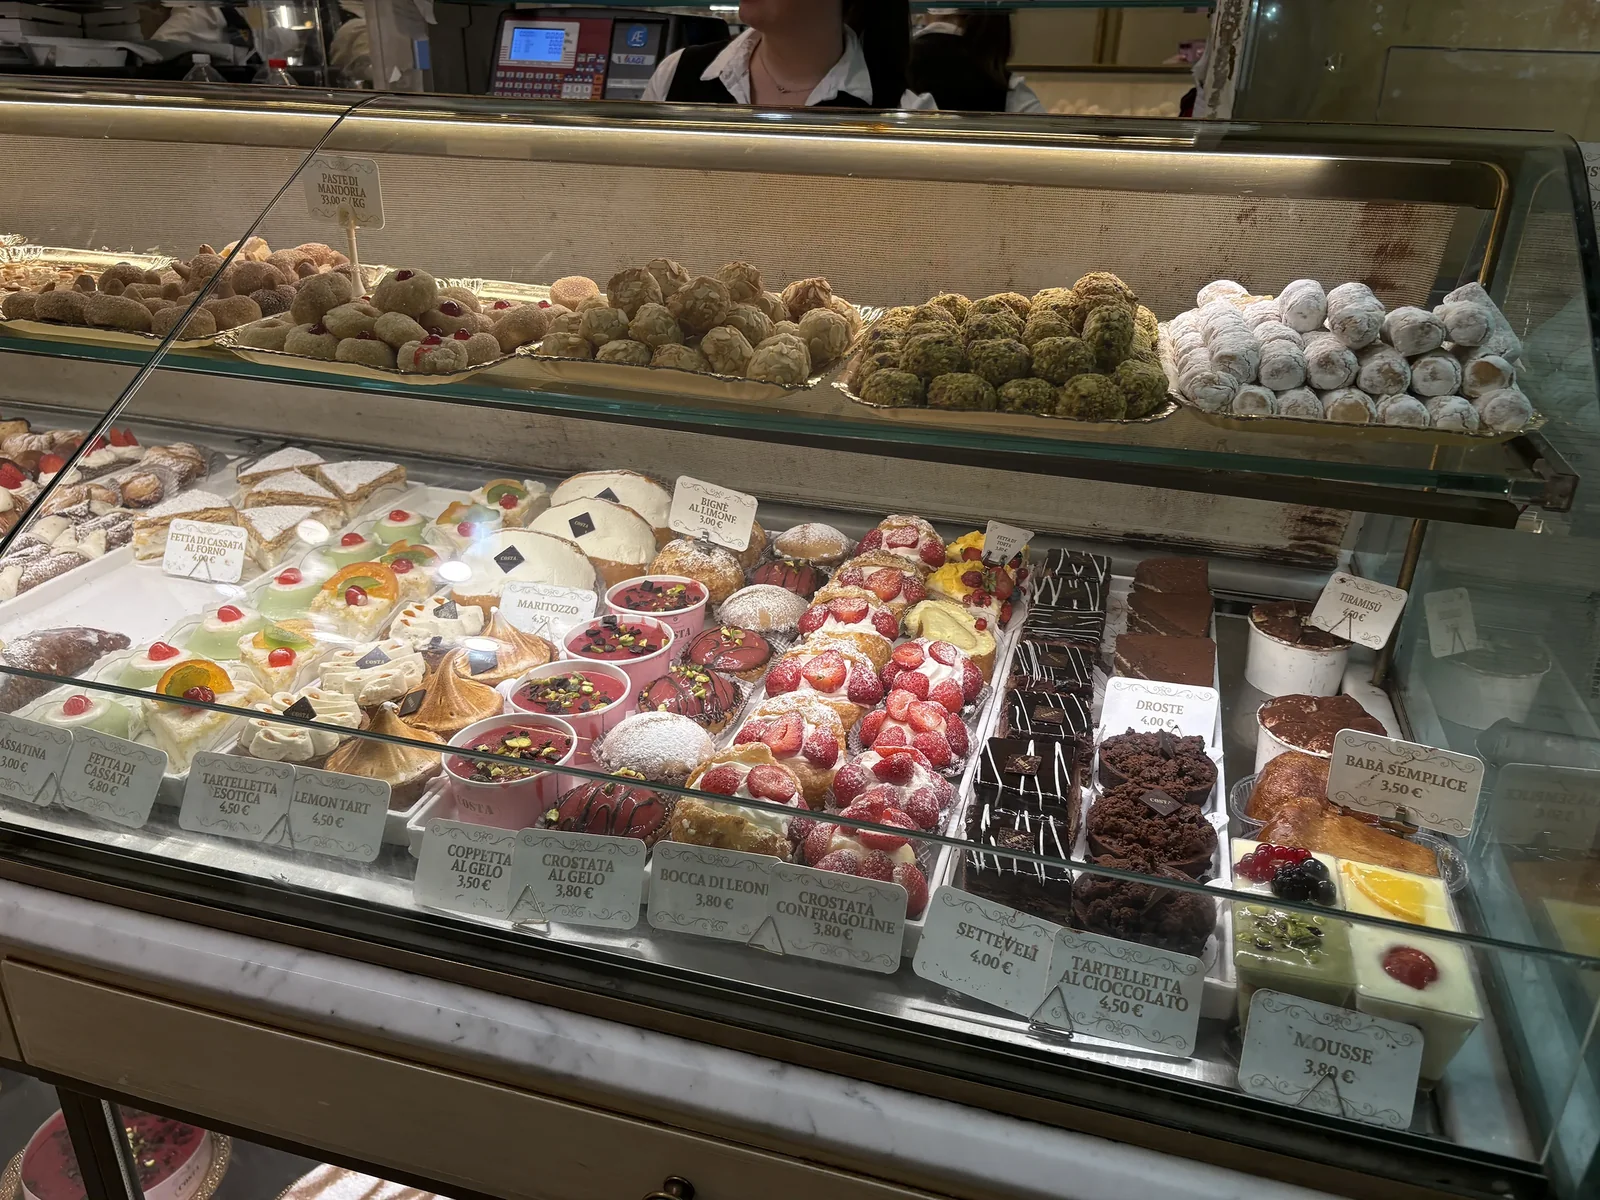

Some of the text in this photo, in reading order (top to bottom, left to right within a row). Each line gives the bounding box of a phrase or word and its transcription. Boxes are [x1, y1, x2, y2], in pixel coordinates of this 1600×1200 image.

[322, 173, 358, 186] PASTE DI
[317, 183, 366, 198] MANDORLA
[321, 195, 340, 205] 33,00
[689, 503, 737, 524] AL LIMONE
[700, 497, 729, 513] BIGNÈ
[170, 533, 244, 550] FETTA DI CASSATA
[184, 544, 227, 556] AL FORNO
[517, 599, 579, 615] MARITOZZO
[1340, 592, 1382, 612] TIRAMISÙ
[1359, 613, 1366, 622] €
[1136, 700, 1184, 715] DROSTE
[1141, 716, 1164, 727] 4,00
[0, 738, 46, 760] ASSATINA
[0, 756, 29, 773] 3,00 €
[88, 752, 136, 775] FETTA DI
[84, 763, 130, 788] CASSATA
[1345, 754, 1468, 793] BABÀ SEMPLICE
[88, 779, 119, 797] 4,80 €
[202, 772, 278, 795] TARTELLETTA
[1380, 780, 1423, 799] 3,50 €
[213, 786, 261, 805] ESOTICA
[293, 791, 371, 815] LEMON TART
[219, 801, 251, 816] 4,50 €
[312, 812, 345, 829] 4,50 €
[447, 843, 512, 867] COPPETTA
[542, 853, 615, 873] CROSTATA
[450, 858, 503, 879] AL GELO
[547, 868, 606, 886] AL GELO
[456, 874, 492, 891] 3,50 €
[555, 883, 594, 899] 3,80 €
[660, 868, 769, 896] BOCCA DI LEONI
[695, 893, 734, 910] 3,80 €
[798, 891, 875, 917] CROSTATA
[776, 900, 896, 935] CON FRAGOLINE
[813, 922, 854, 941] 3,80 €
[956, 921, 1039, 962] SETTEVELI
[969, 949, 1014, 975] 4,00 €
[1071, 956, 1183, 995] TARTELLETTA
[1059, 969, 1189, 1012] AL CIOCCOLATO
[1099, 995, 1145, 1018] 4,50 €
[1293, 1031, 1374, 1065] MOUSSE
[1303, 1059, 1355, 1084] 3,80 €
